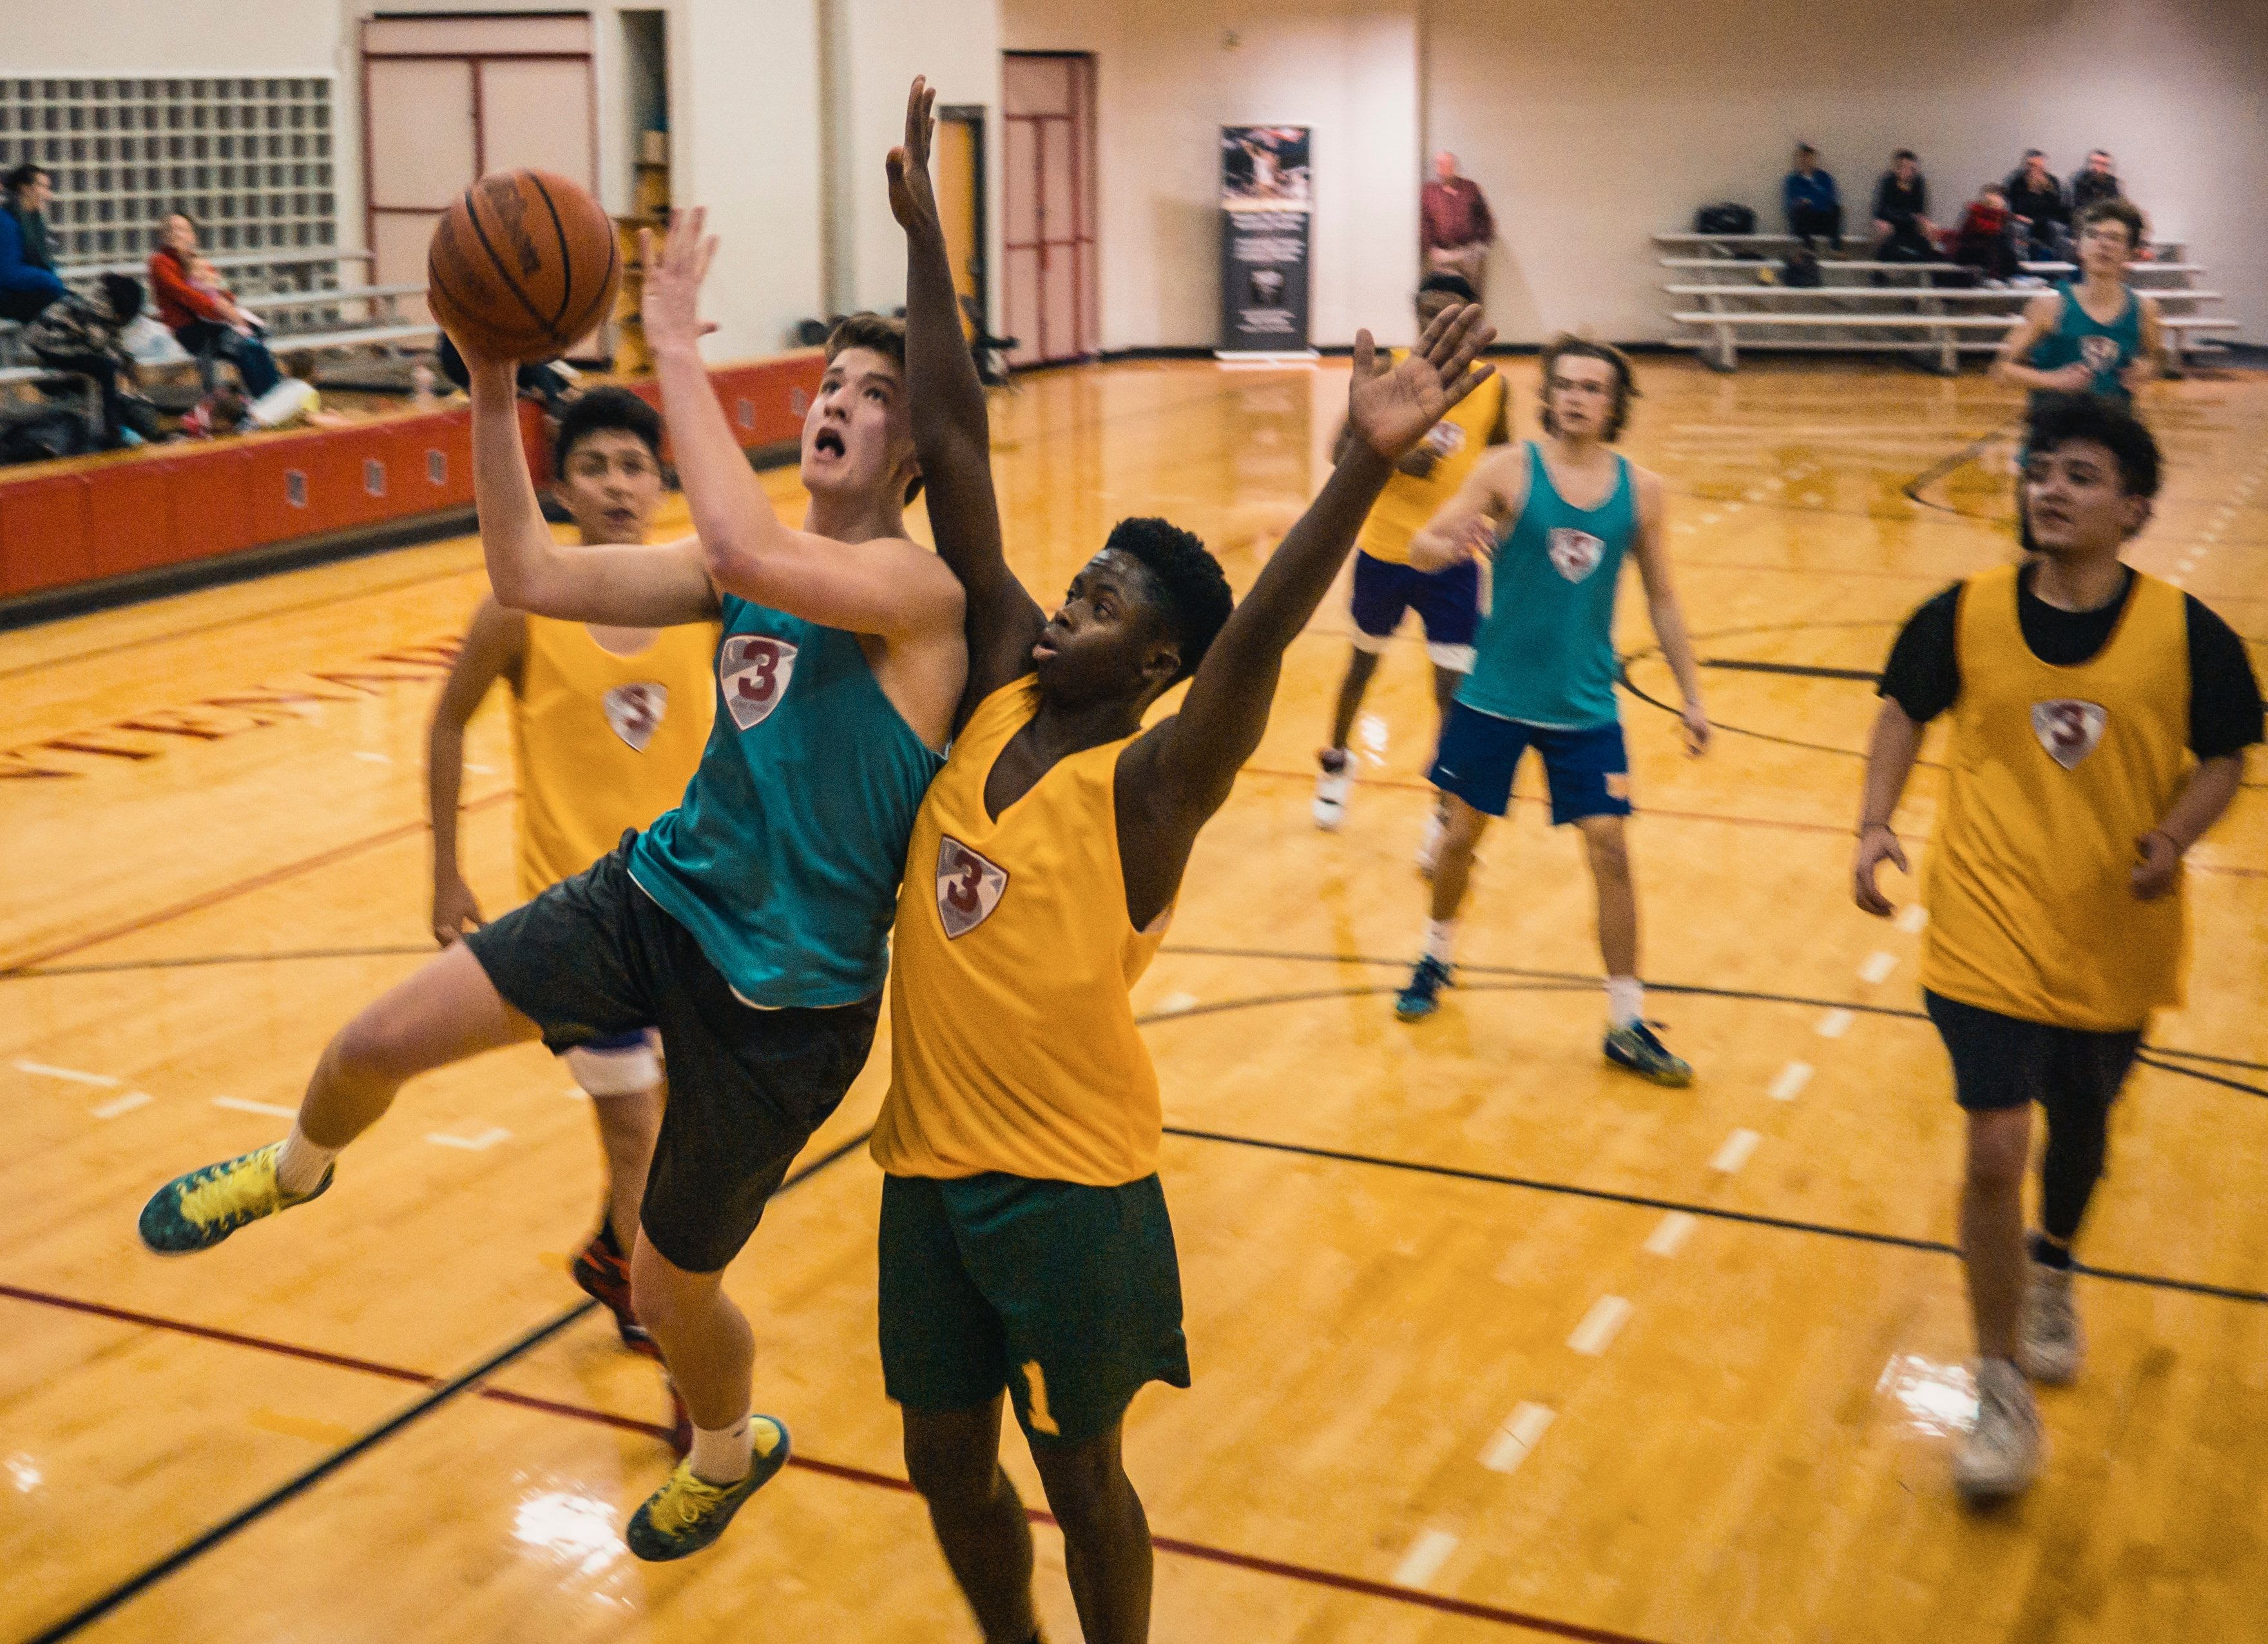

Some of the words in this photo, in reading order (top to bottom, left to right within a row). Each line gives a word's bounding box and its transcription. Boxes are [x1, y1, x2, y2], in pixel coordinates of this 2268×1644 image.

[738, 640, 780, 702] 3
[947, 850, 983, 913] 3
[1021, 1359, 1061, 1436] 1
